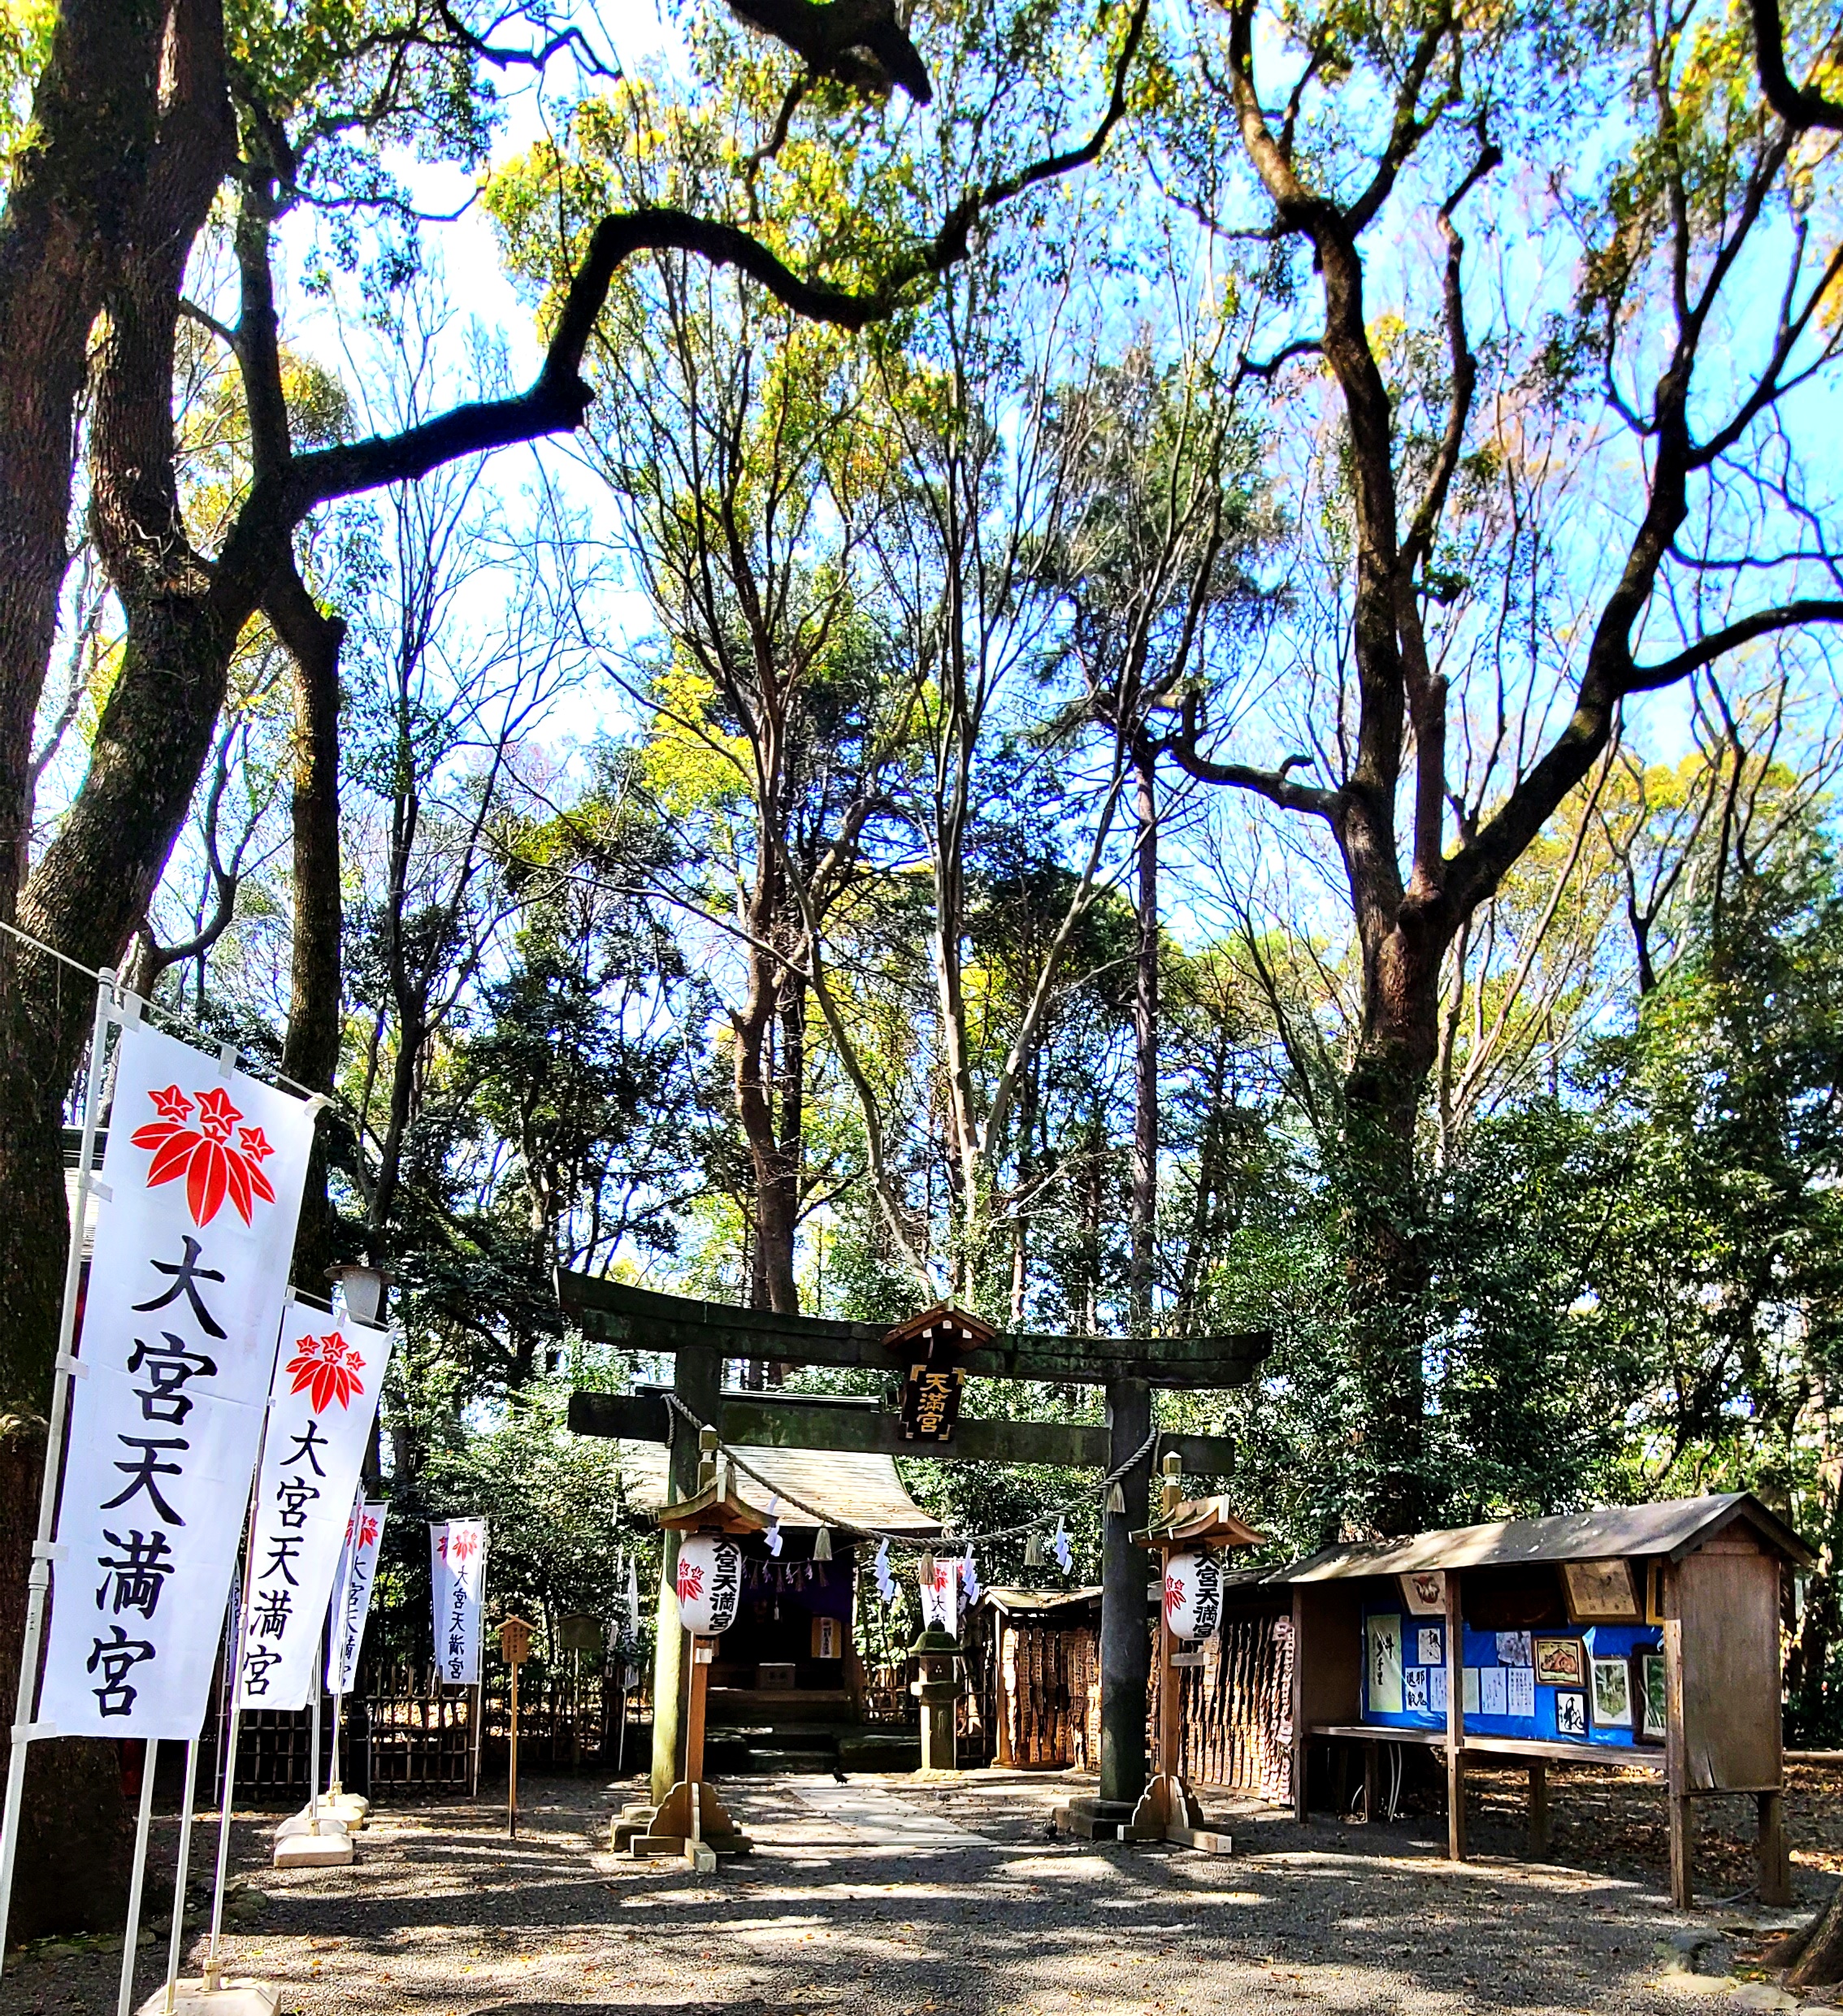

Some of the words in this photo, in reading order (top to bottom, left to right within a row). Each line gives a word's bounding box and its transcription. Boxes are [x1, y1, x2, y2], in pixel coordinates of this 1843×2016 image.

[915, 1372, 952, 1433] 天満宮
[86, 1234, 229, 1718] 大宮天満宮
[242, 1421, 330, 1697] 大宮天満宮
[708, 1536, 739, 1632] 大宮天満宮
[1192, 1551, 1221, 1638] 大宮天満宮
